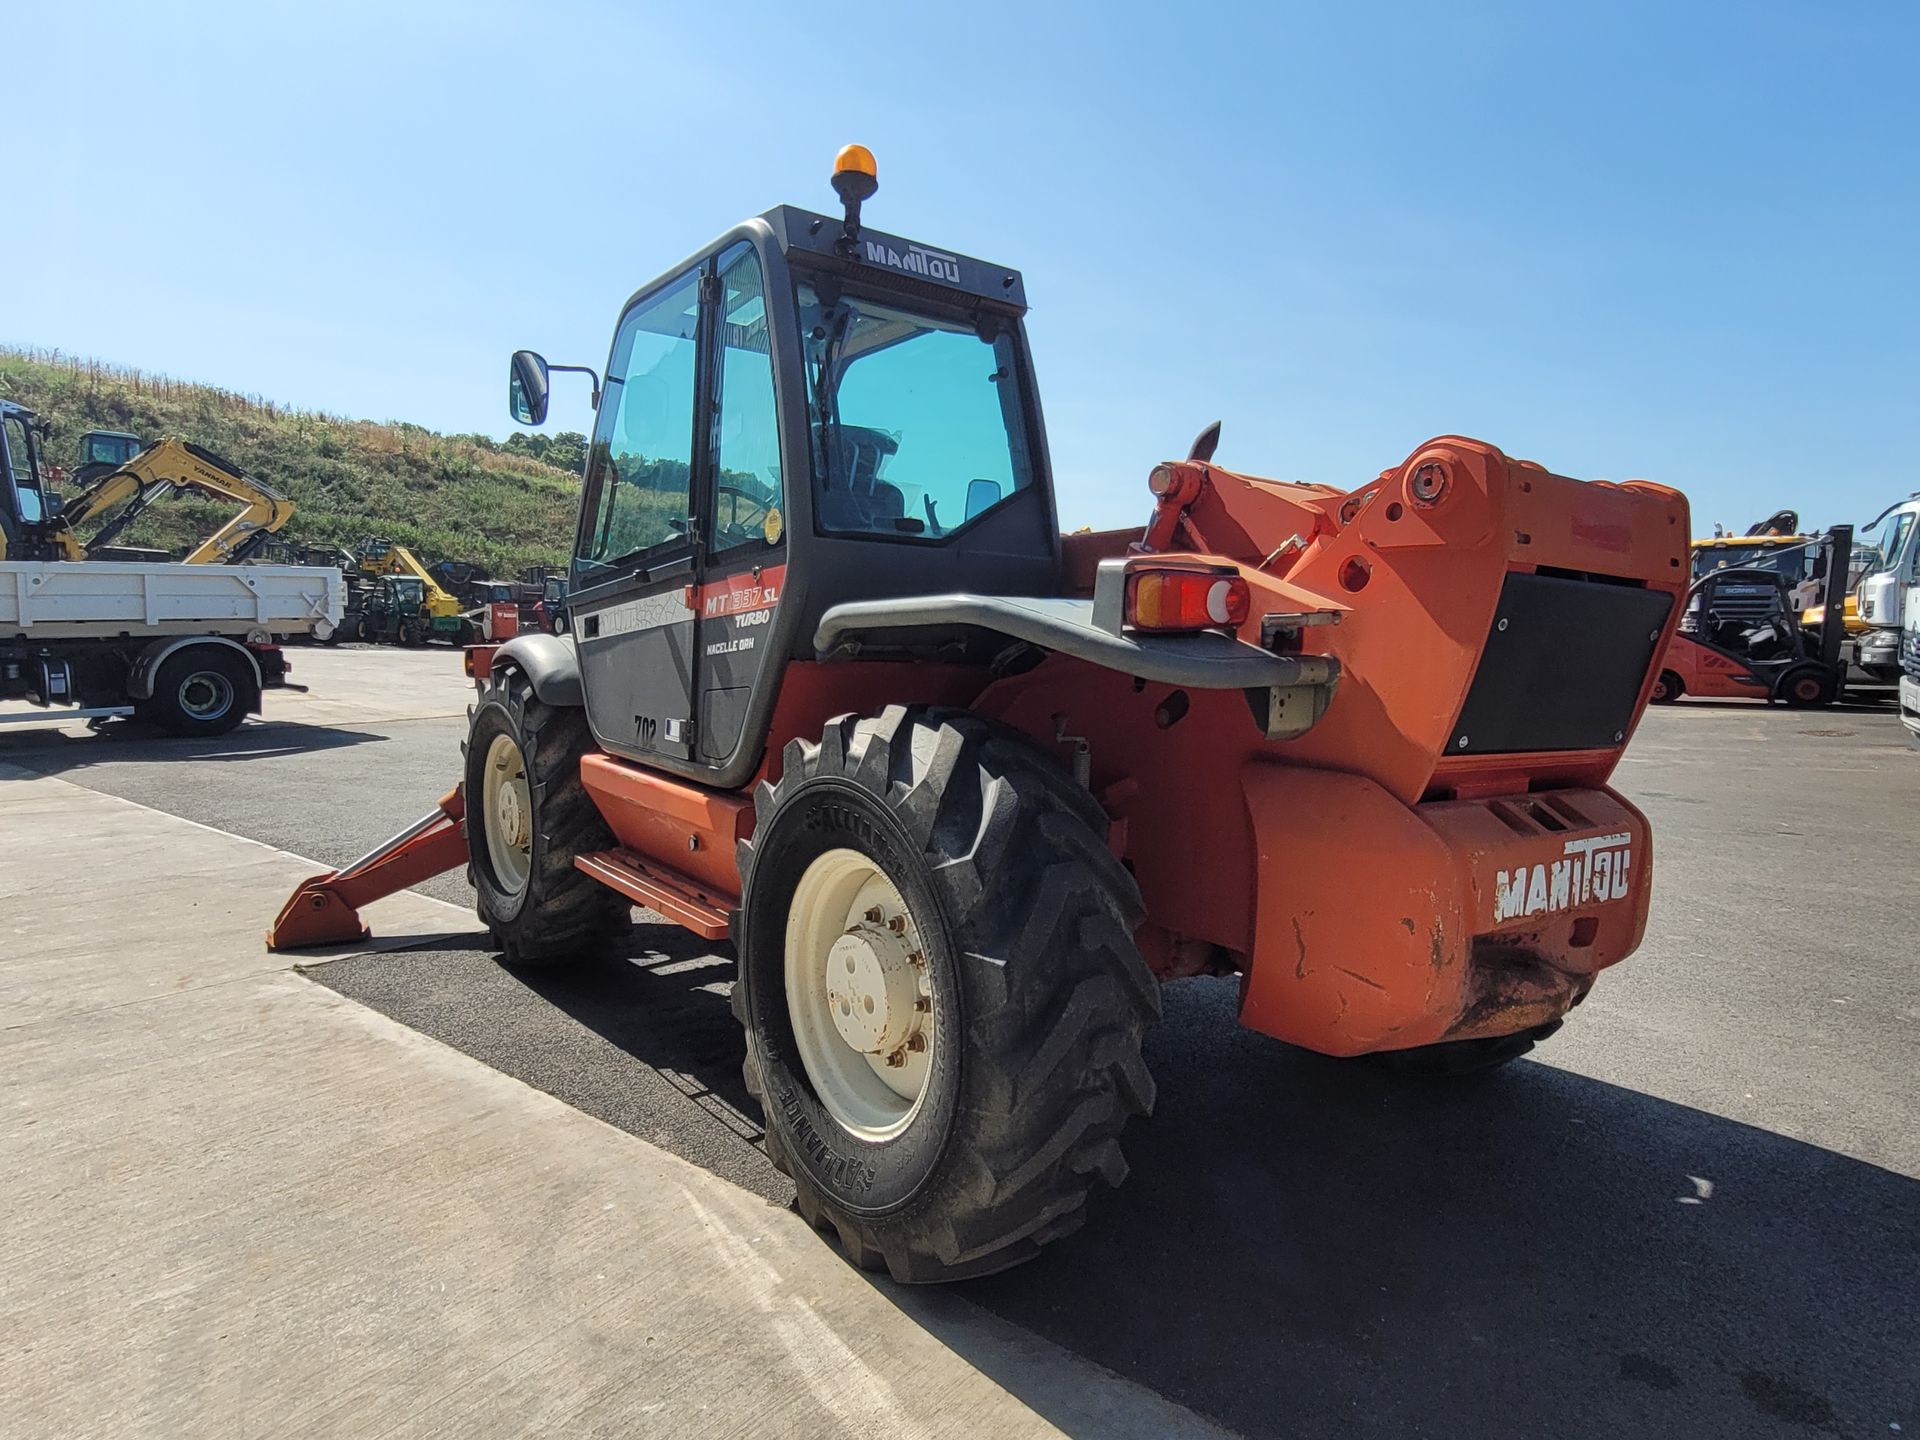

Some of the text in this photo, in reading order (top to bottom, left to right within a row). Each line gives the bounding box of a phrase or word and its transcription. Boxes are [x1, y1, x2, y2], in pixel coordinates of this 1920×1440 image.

[866, 241, 960, 283] MANITOU
[193, 465, 232, 488] YANMAR
[705, 594, 728, 615] MT
[762, 587, 779, 604] SL
[735, 610, 770, 628] TURBO
[707, 640, 738, 656] NACELLE
[634, 715, 656, 749] 702
[1494, 832, 1631, 923] MANITOU
[779, 1087, 864, 1190] ALLIANCE
